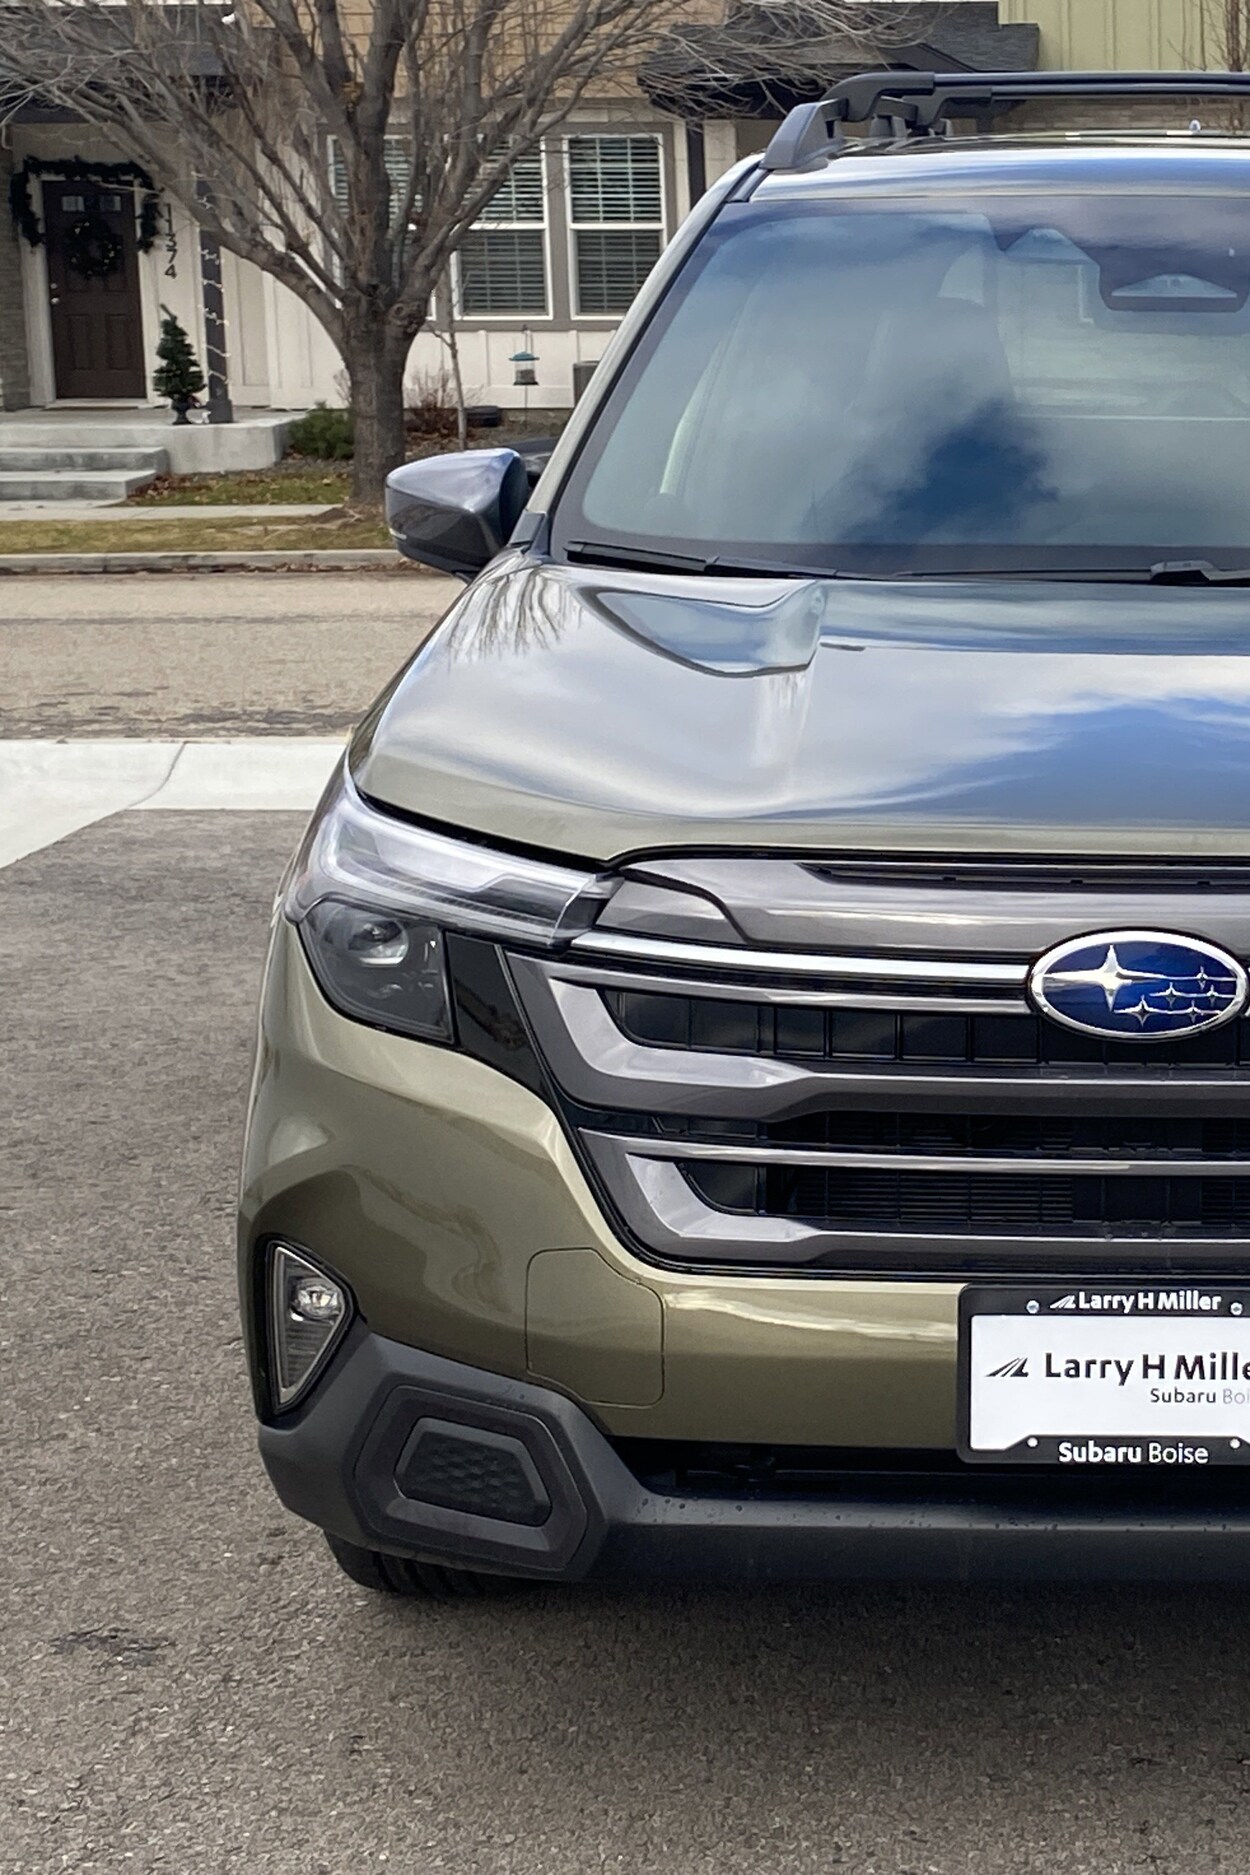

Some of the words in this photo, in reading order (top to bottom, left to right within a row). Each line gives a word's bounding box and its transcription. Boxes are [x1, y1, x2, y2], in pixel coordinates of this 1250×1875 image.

[1078, 1291, 1135, 1313] Larry
[1138, 1292, 1155, 1310] H
[1157, 1290, 1222, 1311] Miller
[1045, 1352, 1135, 1386] Larry
[1142, 1354, 1166, 1379] H
[1150, 1388, 1217, 1404] Subaru
[1058, 1441, 1142, 1463] Subaru
[1149, 1442, 1209, 1464] Boise
